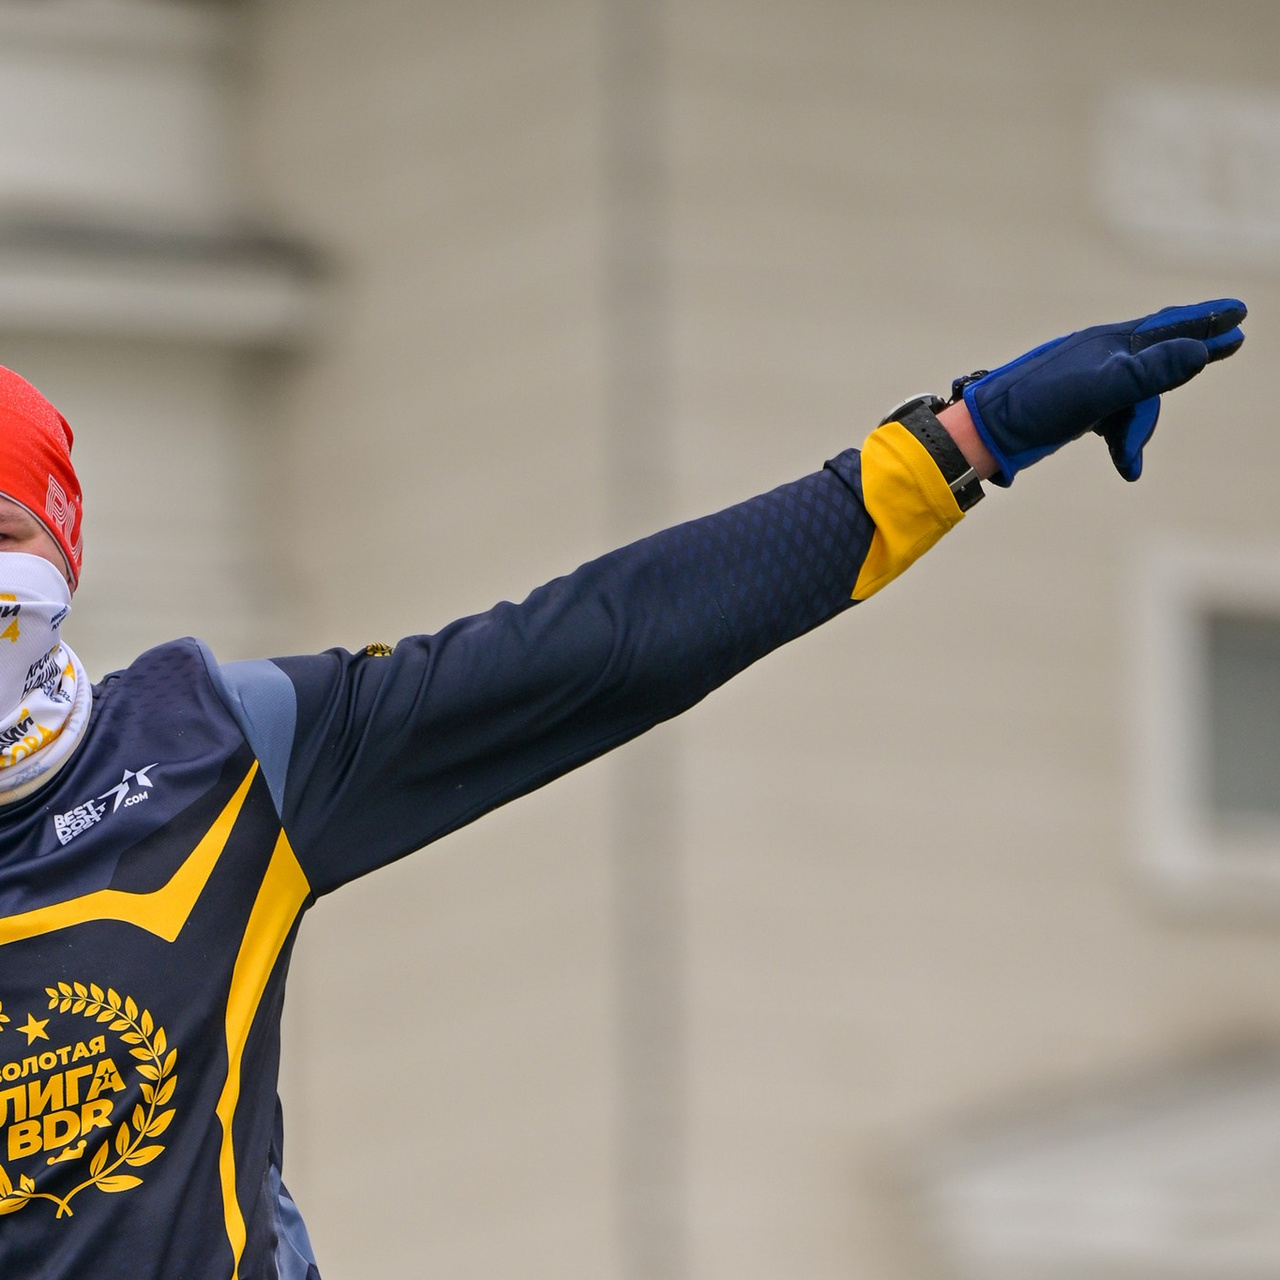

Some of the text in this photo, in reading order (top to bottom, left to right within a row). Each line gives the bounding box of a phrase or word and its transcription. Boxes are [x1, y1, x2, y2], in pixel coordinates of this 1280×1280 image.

[53, 799, 96, 829] BEST
[123, 791, 149, 807] .COM
[7, 1098, 114, 1162] BDR
